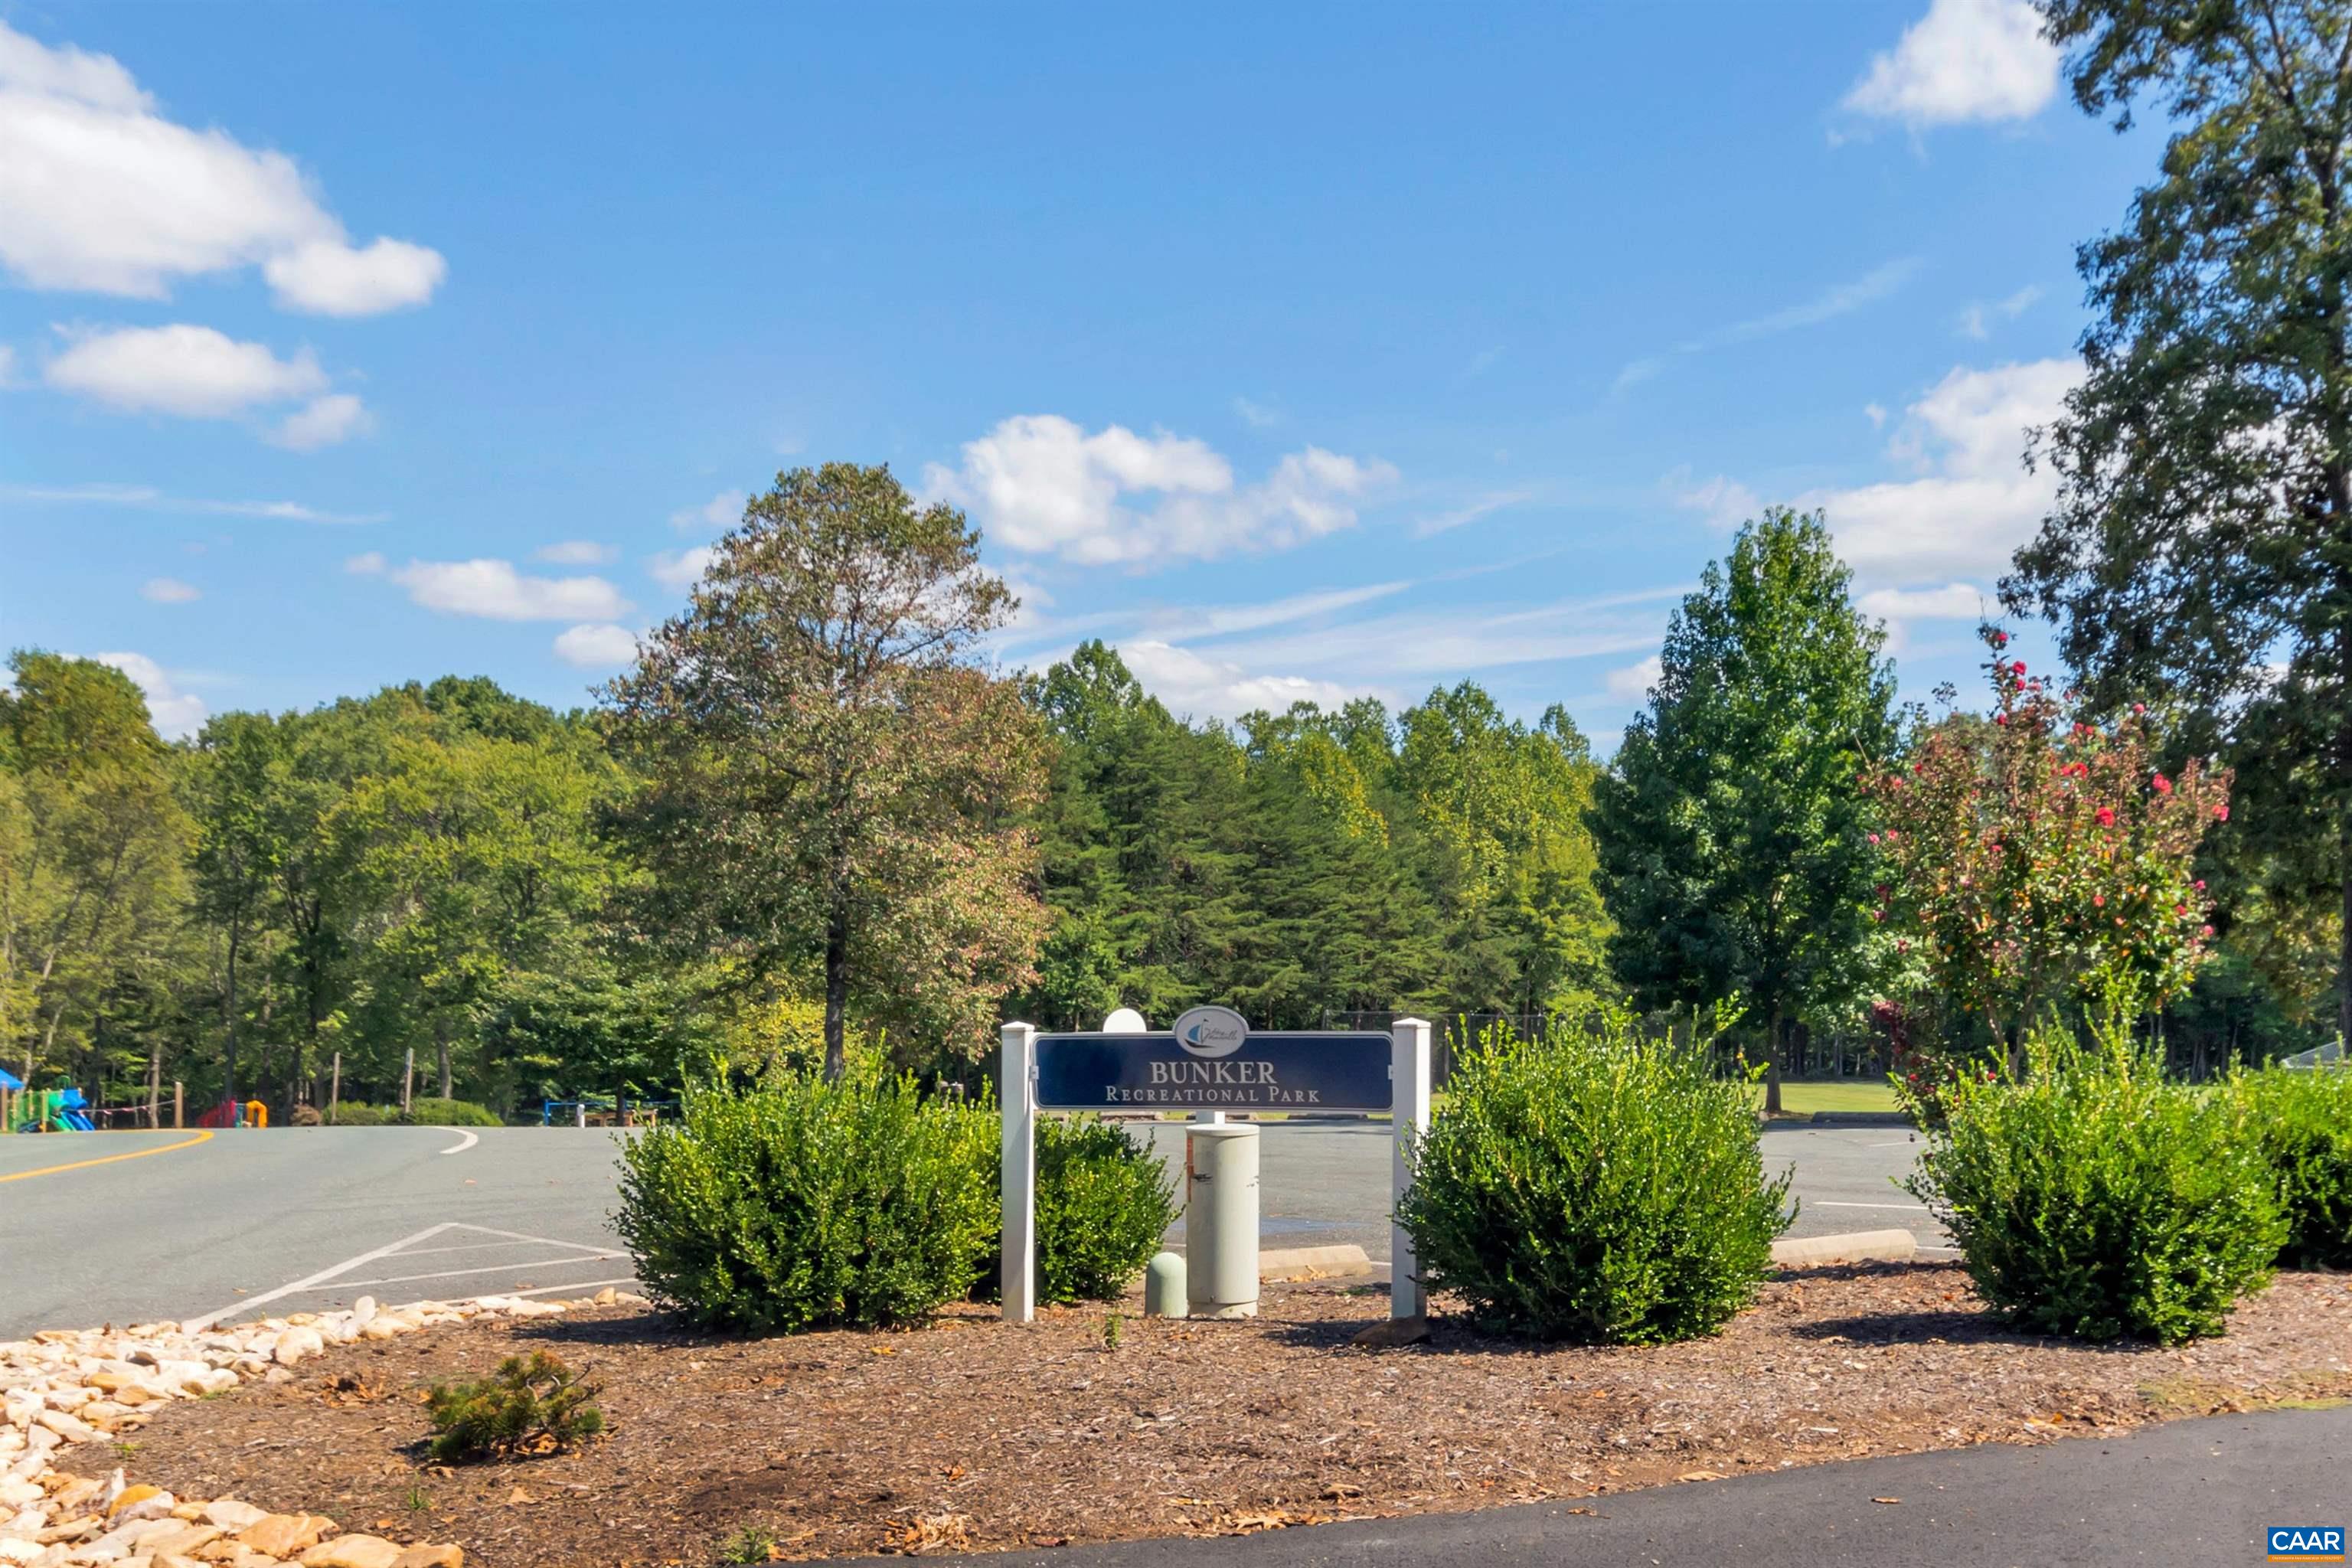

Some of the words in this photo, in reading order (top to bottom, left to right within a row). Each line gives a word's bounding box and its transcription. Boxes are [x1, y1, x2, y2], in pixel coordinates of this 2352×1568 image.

[1149, 1061, 1278, 1084] BUNKER
[1106, 1086, 1259, 1102] RECREATIONAL
[1268, 1086, 1321, 1103] PARK
